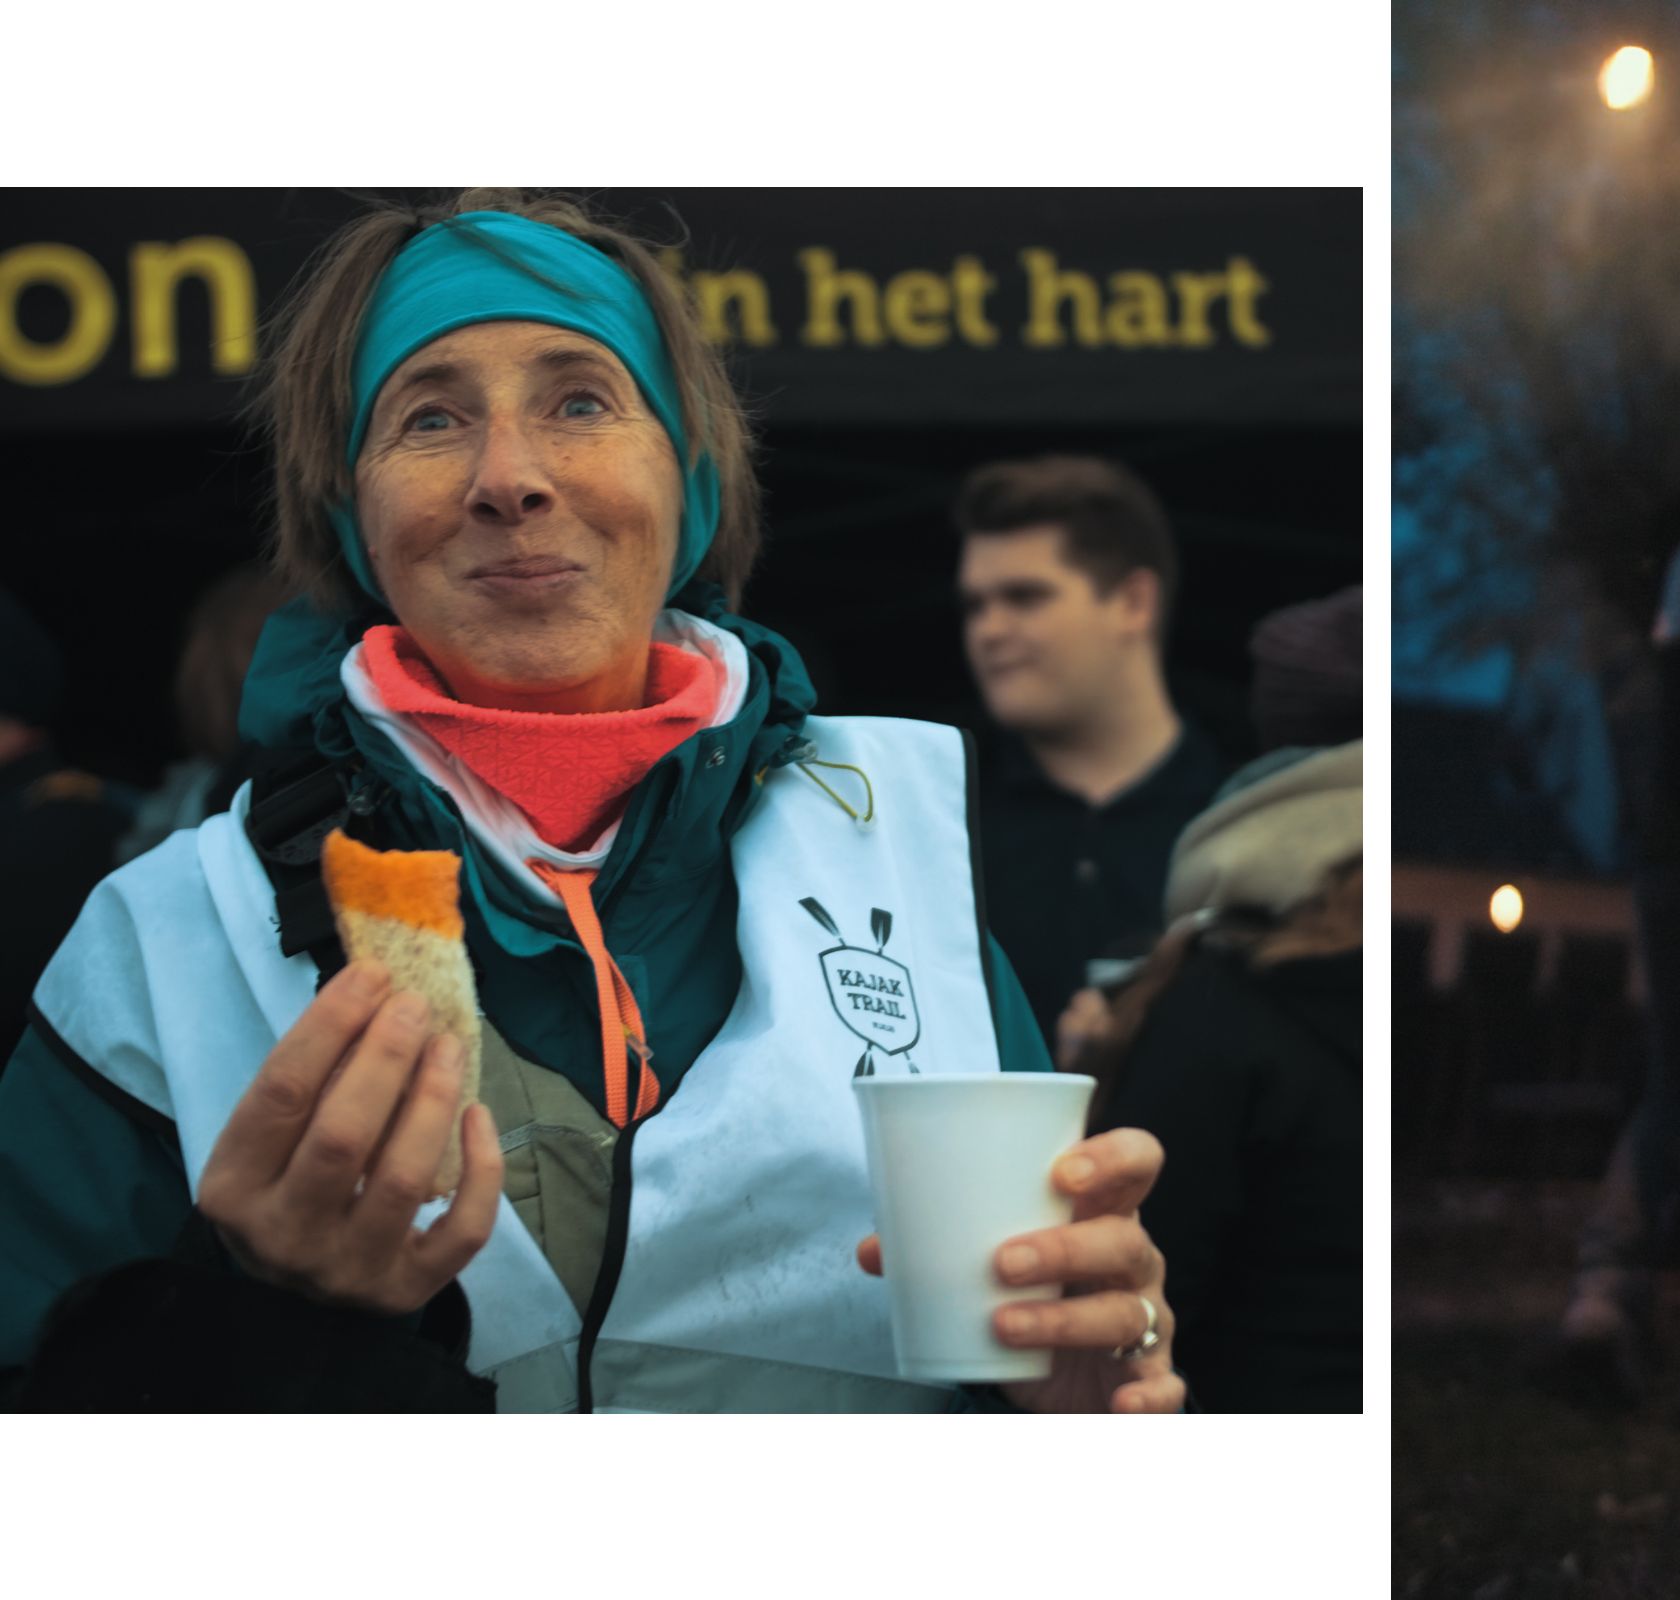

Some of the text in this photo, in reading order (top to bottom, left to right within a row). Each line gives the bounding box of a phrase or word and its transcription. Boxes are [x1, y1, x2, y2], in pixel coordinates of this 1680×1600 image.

[0, 236, 256, 384] on
[800, 249, 996, 347] het
[1022, 249, 1268, 347] hart
[837, 969, 904, 997] KAJAK
[847, 992, 906, 1019] TRAIL
